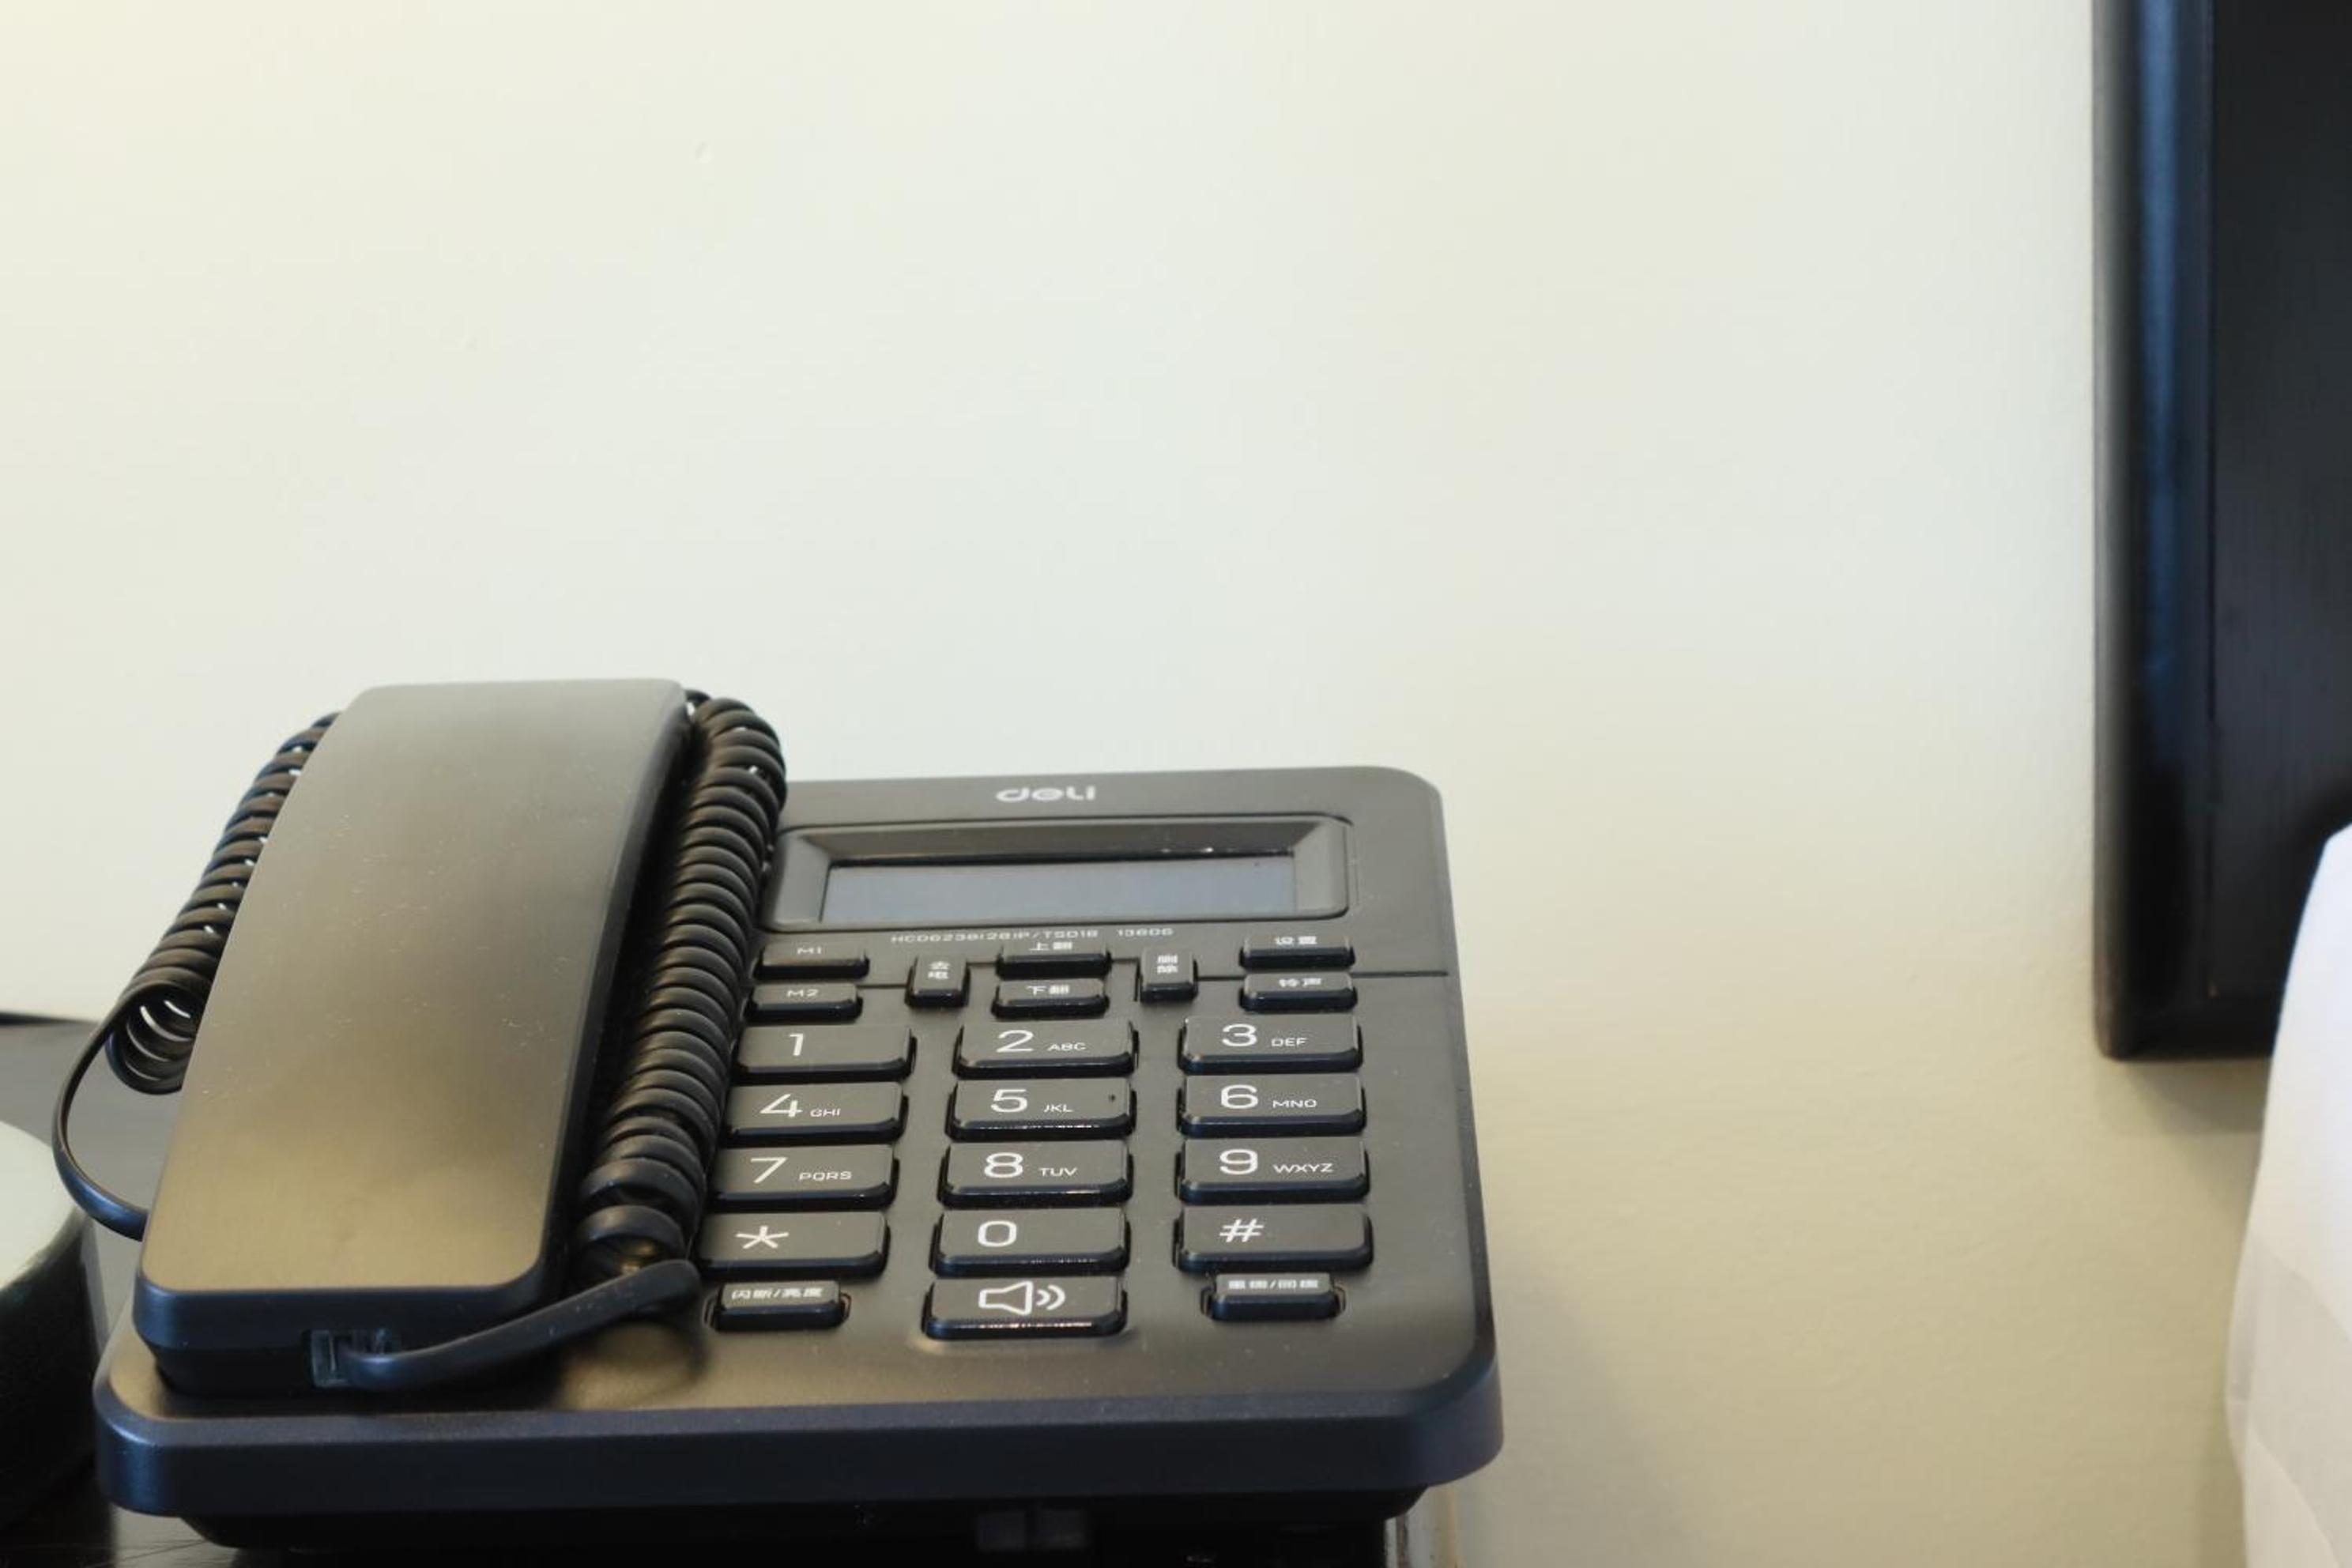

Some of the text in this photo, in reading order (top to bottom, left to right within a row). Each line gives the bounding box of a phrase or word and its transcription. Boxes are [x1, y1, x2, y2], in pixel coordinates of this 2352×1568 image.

[996, 786, 1095, 802] deli
[797, 946, 822, 955] M1
[786, 989, 819, 997] M2
[790, 1033, 804, 1057] 1
[997, 1029, 1086, 1053] 2 ABC
[1222, 1023, 1307, 1047] 3 DEF
[760, 1093, 841, 1118] 4 GHI
[990, 1088, 1072, 1113] 5 JKL
[1220, 1084, 1317, 1110] 6 MNO
[751, 1156, 852, 1184] 7 PQRS
[984, 1152, 1077, 1178] 8 TUV
[1219, 1148, 1332, 1175] 9 WXYZ
[978, 1220, 1017, 1247] 0
